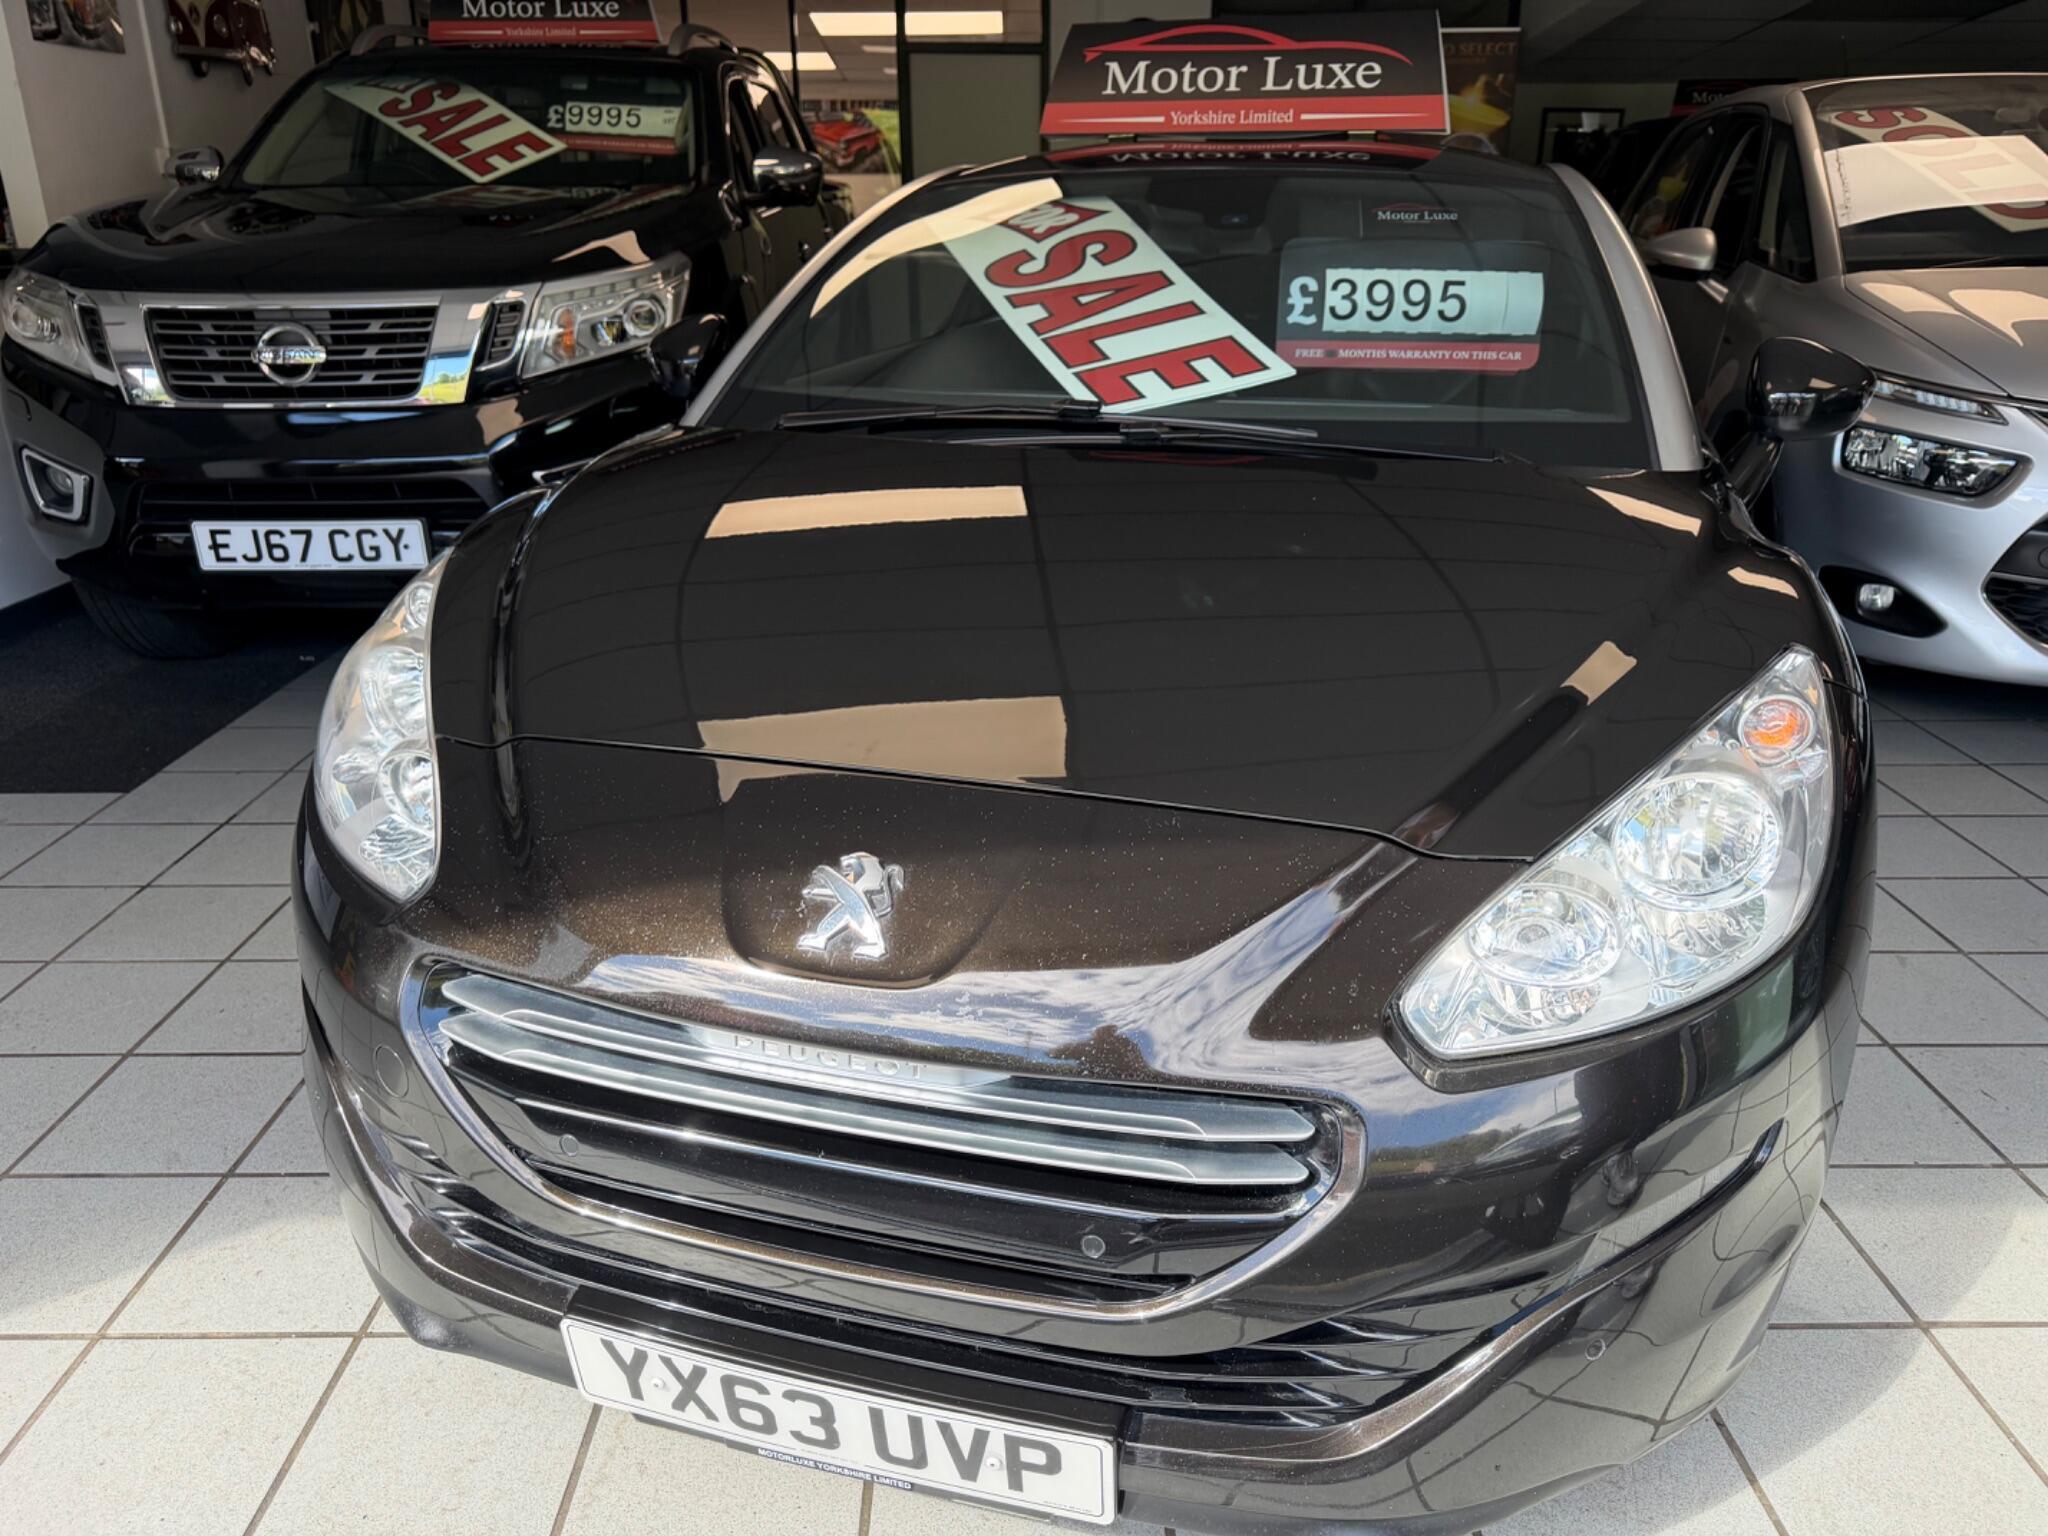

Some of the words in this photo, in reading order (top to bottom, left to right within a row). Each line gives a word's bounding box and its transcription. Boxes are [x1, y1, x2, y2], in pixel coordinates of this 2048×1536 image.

[461, 0, 545, 18] Motor
[554, 0, 620, 18] Luxe
[1458, 42, 1517, 56] SELECT
[1101, 60, 1248, 96] Motor
[1260, 56, 1382, 92] Luxe
[378, 81, 553, 178] SALE
[547, 104, 642, 128] £9995
[1170, 111, 1236, 126] Yorkshire
[1239, 109, 1294, 124] Limited
[1377, 211, 1421, 221] Motor
[1424, 211, 1459, 221] Luxe
[984, 230, 1271, 405] SALE
[1286, 276, 1467, 325] £3995
[1295, 347, 1325, 359] FREE
[1338, 348, 1388, 359] MONTHS
[1389, 348, 1451, 360] WARRANTY
[1452, 349, 1469, 360] ON
[1471, 349, 1498, 361] THIS
[1499, 349, 1523, 361] CAR
[208, 528, 314, 563] EJ67
[328, 527, 406, 563] CGY
[733, 1034, 929, 1080] PEUGEOT
[599, 1337, 842, 1451] YX63
[868, 1406, 1062, 1492] UVP
[757, 1447, 815, 1467] MOTORLUXE
[816, 1460, 872, 1481] YORKSHIRE
[873, 1475, 913, 1490] LIMITED
